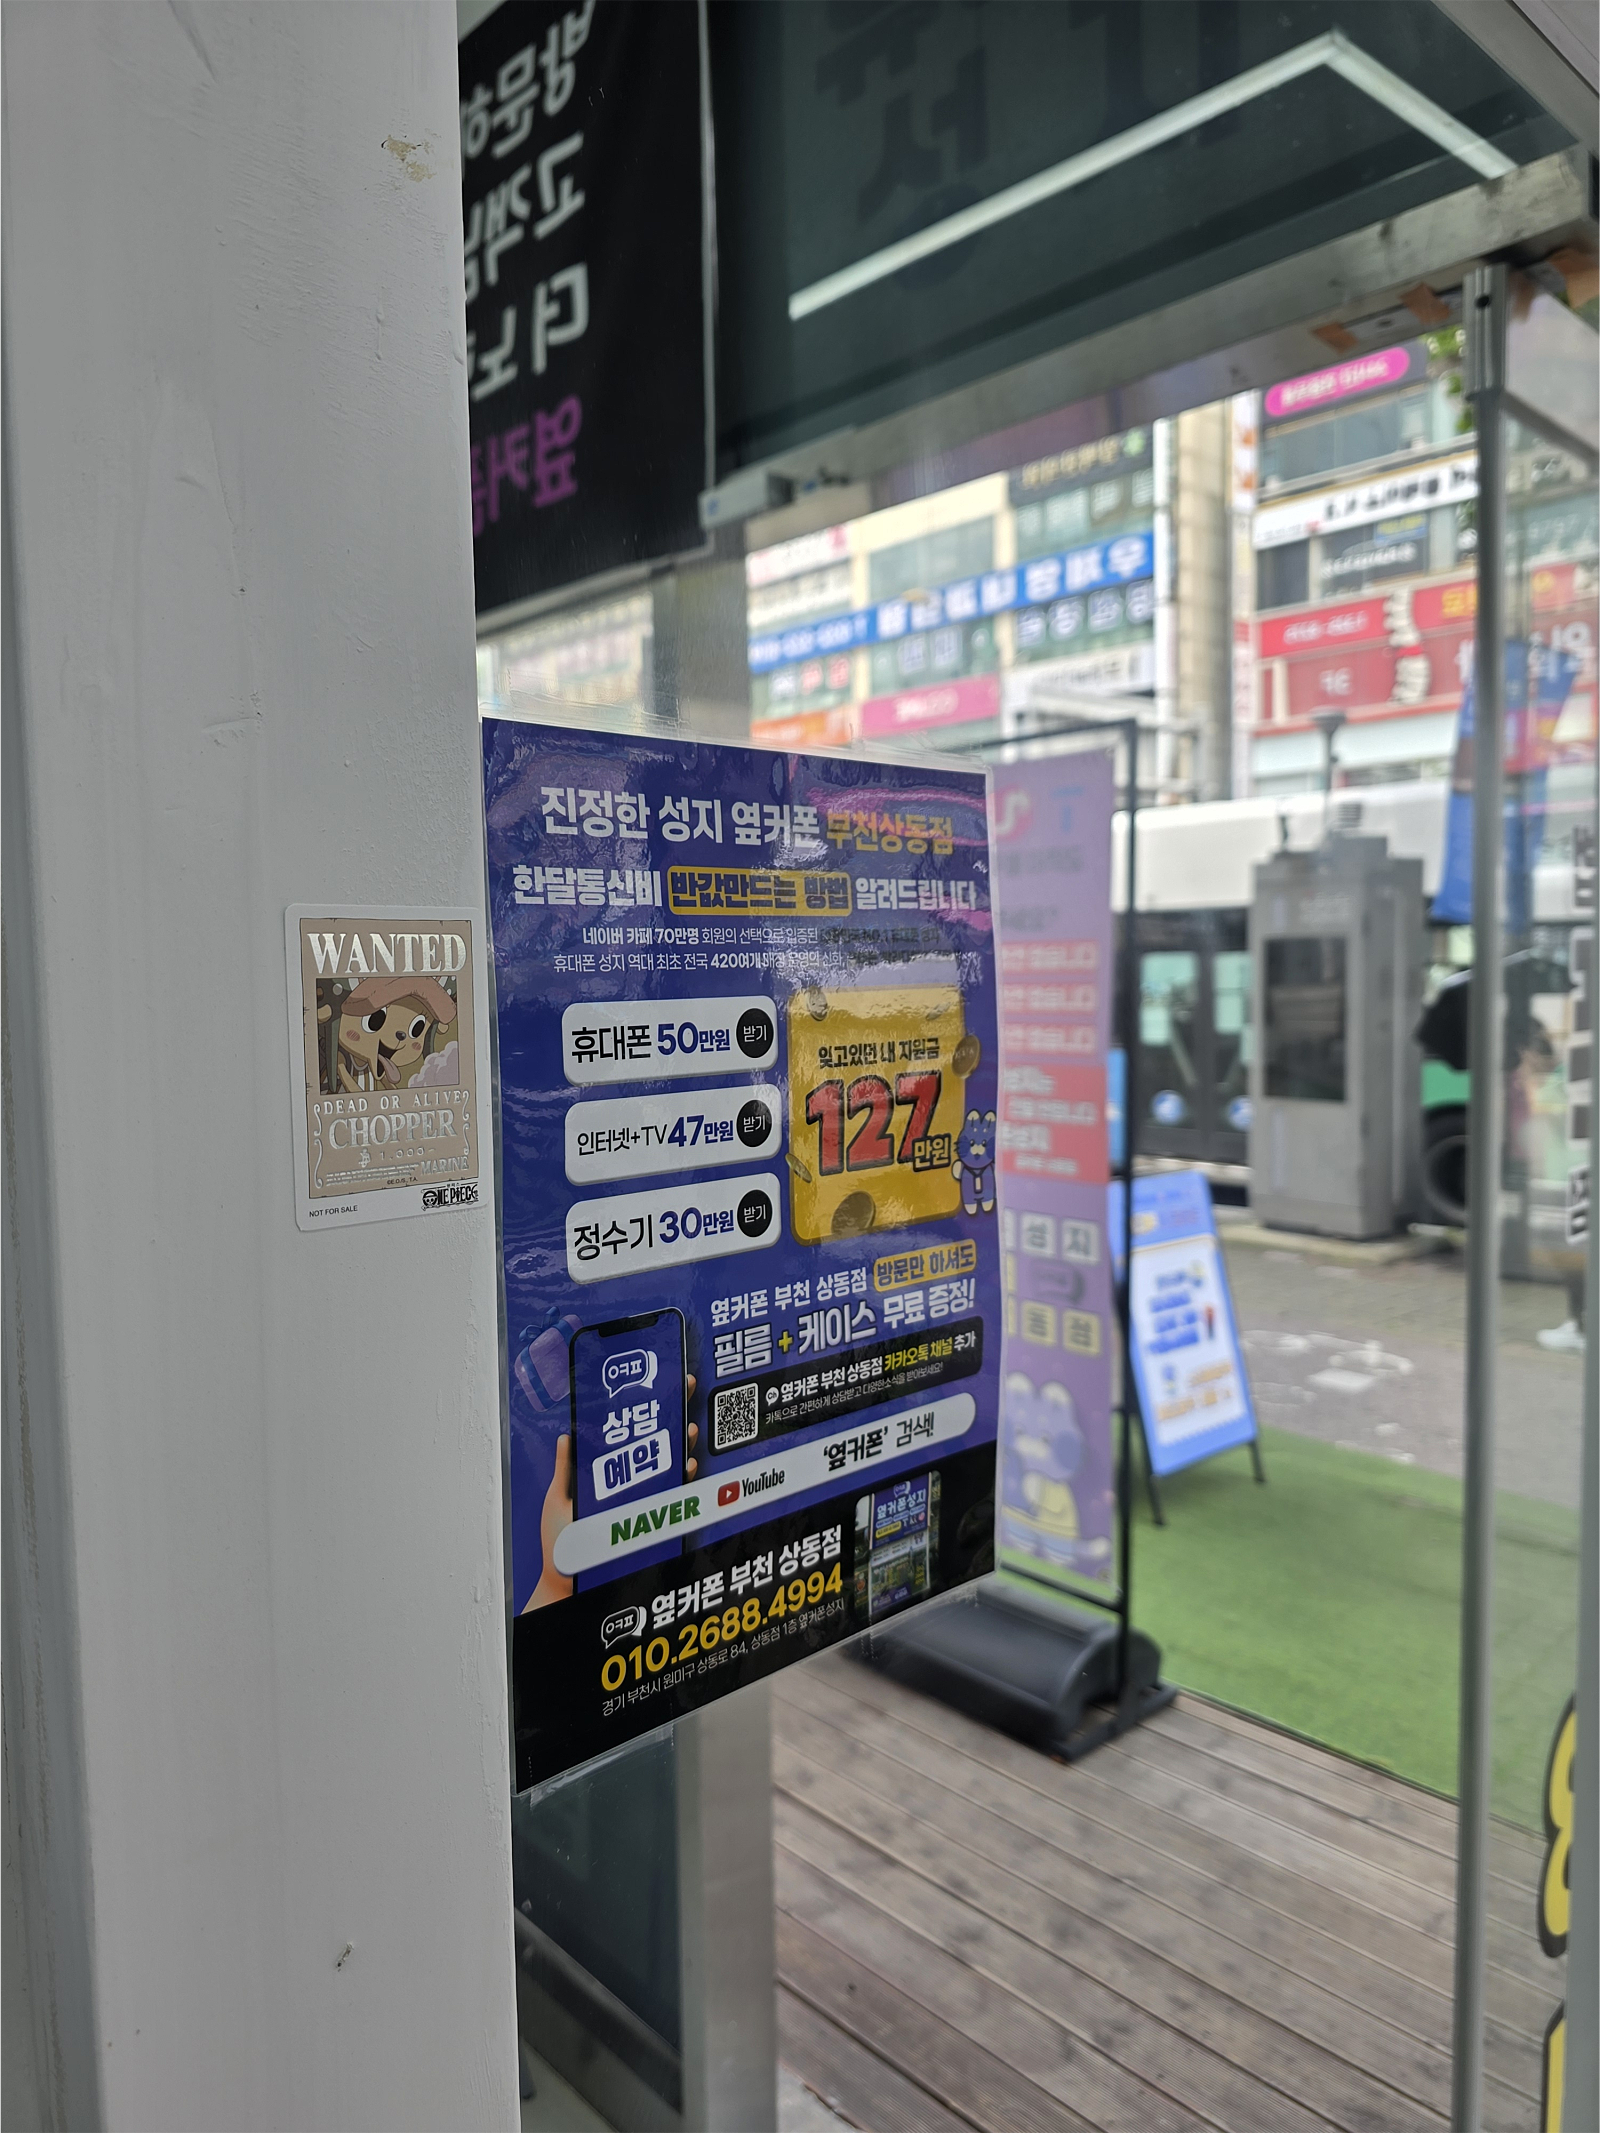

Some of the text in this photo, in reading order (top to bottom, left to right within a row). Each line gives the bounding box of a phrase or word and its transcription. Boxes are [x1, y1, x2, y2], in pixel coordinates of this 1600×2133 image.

[541, 786, 954, 856] 진정한 성지 옆커폰 부천상동점
[512, 864, 977, 912] 한달통신비 반값만드는 방법 알려드립니다
[307, 933, 467, 974] WANTED
[582, 927, 624, 945] 네이버
[626, 927, 652, 945] 카페
[654, 927, 700, 945] 70만명
[701, 927, 737, 945] 회원의
[739, 927, 785, 945] 선택으로
[786, 927, 818, 944] 입증된
[553, 954, 596, 973] 휴대폰
[598, 954, 625, 972] 성지
[628, 953, 655, 971] 역대
[656, 953, 682, 970] 최초
[684, 953, 709, 970] 전국
[711, 952, 762, 969] 420여개
[571, 1021, 731, 1063] 휴대폰 50만원
[743, 1025, 768, 1042] 받기
[898, 1037, 940, 1061] 지원금
[323, 1090, 461, 1115] DEAD OR ALIVE
[328, 1109, 458, 1150] CHOPPER
[667, 1114, 735, 1148] 47만원
[743, 1115, 766, 1133] 받기
[421, 1156, 470, 1176] MARINE
[309, 1204, 358, 1218] NOT FOR SALE
[743, 1204, 767, 1224] 받기
[574, 1206, 735, 1261] 정수기 30만원
[710, 1243, 975, 1327] 옆커폰 부천 상동점 방문만 하셔도
[713, 1323, 773, 1378] 필름
[798, 1300, 877, 1354] 케이스
[883, 1290, 926, 1330] 무료
[928, 1277, 976, 1319] 증정!
[780, 1379, 819, 1403] 옆커폰
[820, 1367, 846, 1391] 부천
[847, 1356, 884, 1384] 상동점
[884, 1344, 929, 1372] 카카오톡
[930, 1336, 954, 1360] 채널
[954, 1330, 977, 1351] 추가
[603, 1399, 660, 1445] 상담
[765, 1404, 799, 1425] 카톡으로
[799, 1395, 831, 1415] 간편하게
[831, 1384, 862, 1405] 상담받고
[895, 1411, 935, 1448] 검색!
[604, 1439, 660, 1489] 예약
[741, 1468, 785, 1498] YouTube
[610, 1495, 702, 1546] NAVER
[652, 1574, 724, 1630] 옆커폰
[729, 1553, 774, 1597] 부천
[779, 1525, 843, 1577] 상동점
[600, 1562, 844, 1692] 010.2688.4994
[602, 1697, 626, 1717] 경기
[627, 1681, 662, 1704] 부천시
[663, 1664, 696, 1690] 원미구
[696, 1648, 729, 1675] 상동로
[750, 1627, 781, 1651] 상동점
[782, 1616, 798, 1636] 1층
